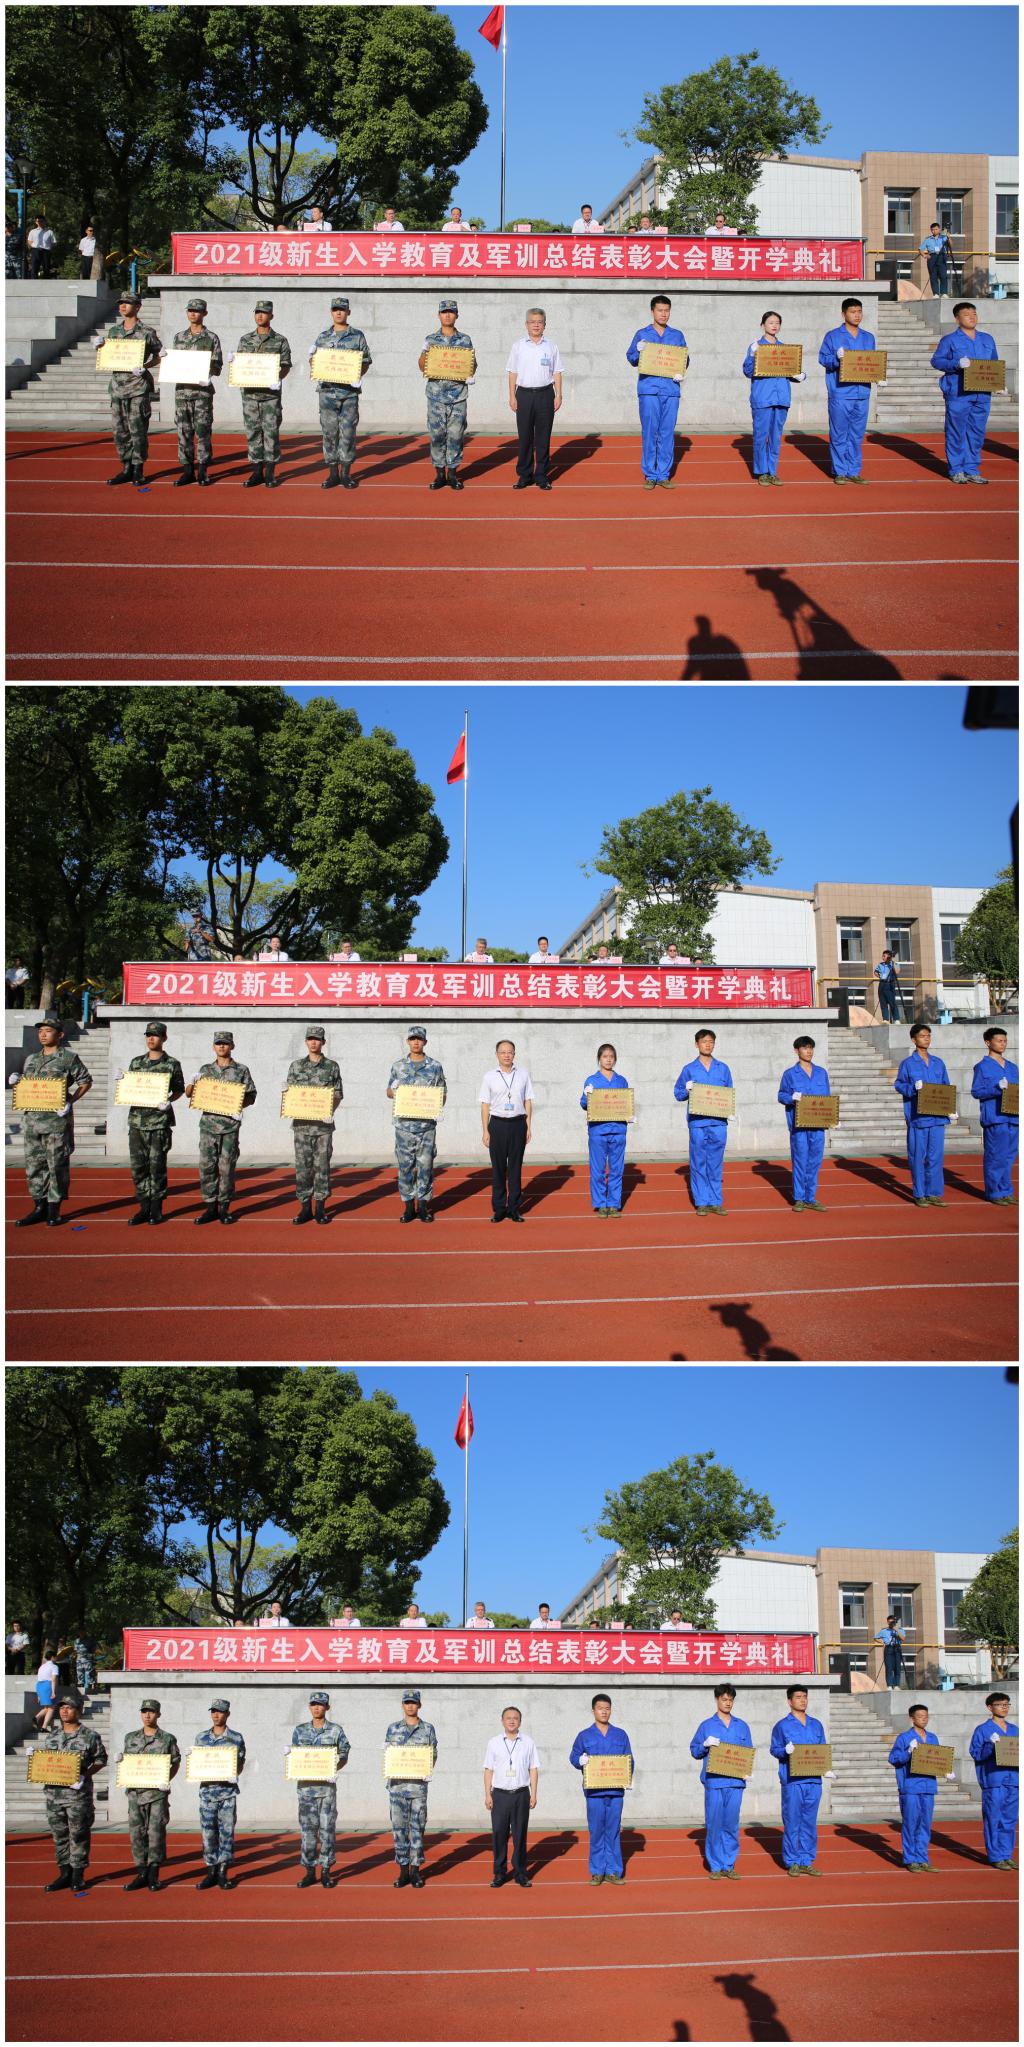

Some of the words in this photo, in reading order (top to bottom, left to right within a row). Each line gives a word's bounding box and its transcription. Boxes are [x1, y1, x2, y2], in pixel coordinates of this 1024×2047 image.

[193, 241, 842, 272] 2021级新生入学教育及军训总结表彰大会暨开学典礼
[145, 971, 793, 1000] 2021级新生入学教育及军训总结表彰大会暨开学典礼
[145, 1636, 794, 1666] 2021级新生入学教育及军训总结表彰大会暨开学典礼
